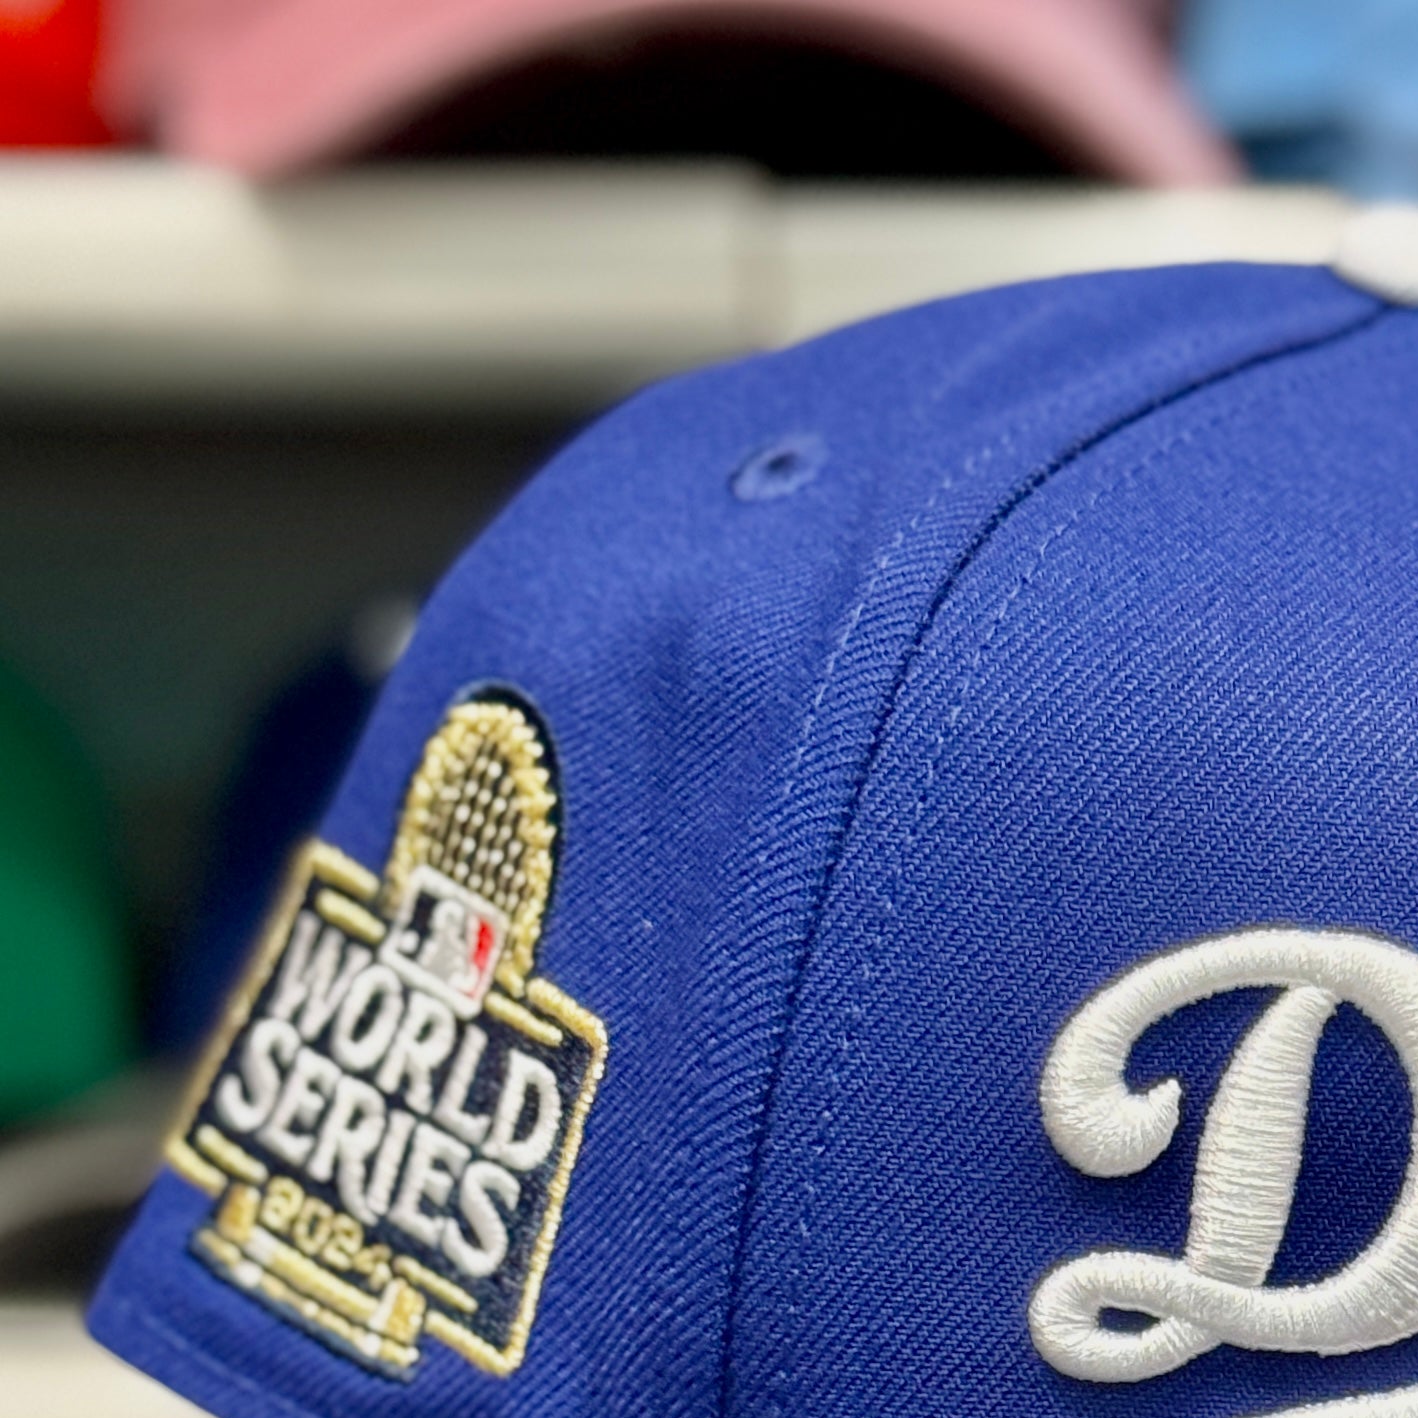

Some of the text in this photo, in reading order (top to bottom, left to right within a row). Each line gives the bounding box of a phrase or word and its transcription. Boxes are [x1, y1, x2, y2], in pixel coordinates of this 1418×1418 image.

[216, 1016, 521, 1277] SERIES
[267, 908, 562, 1170] WORLD
[261, 1175, 393, 1292] 2024
